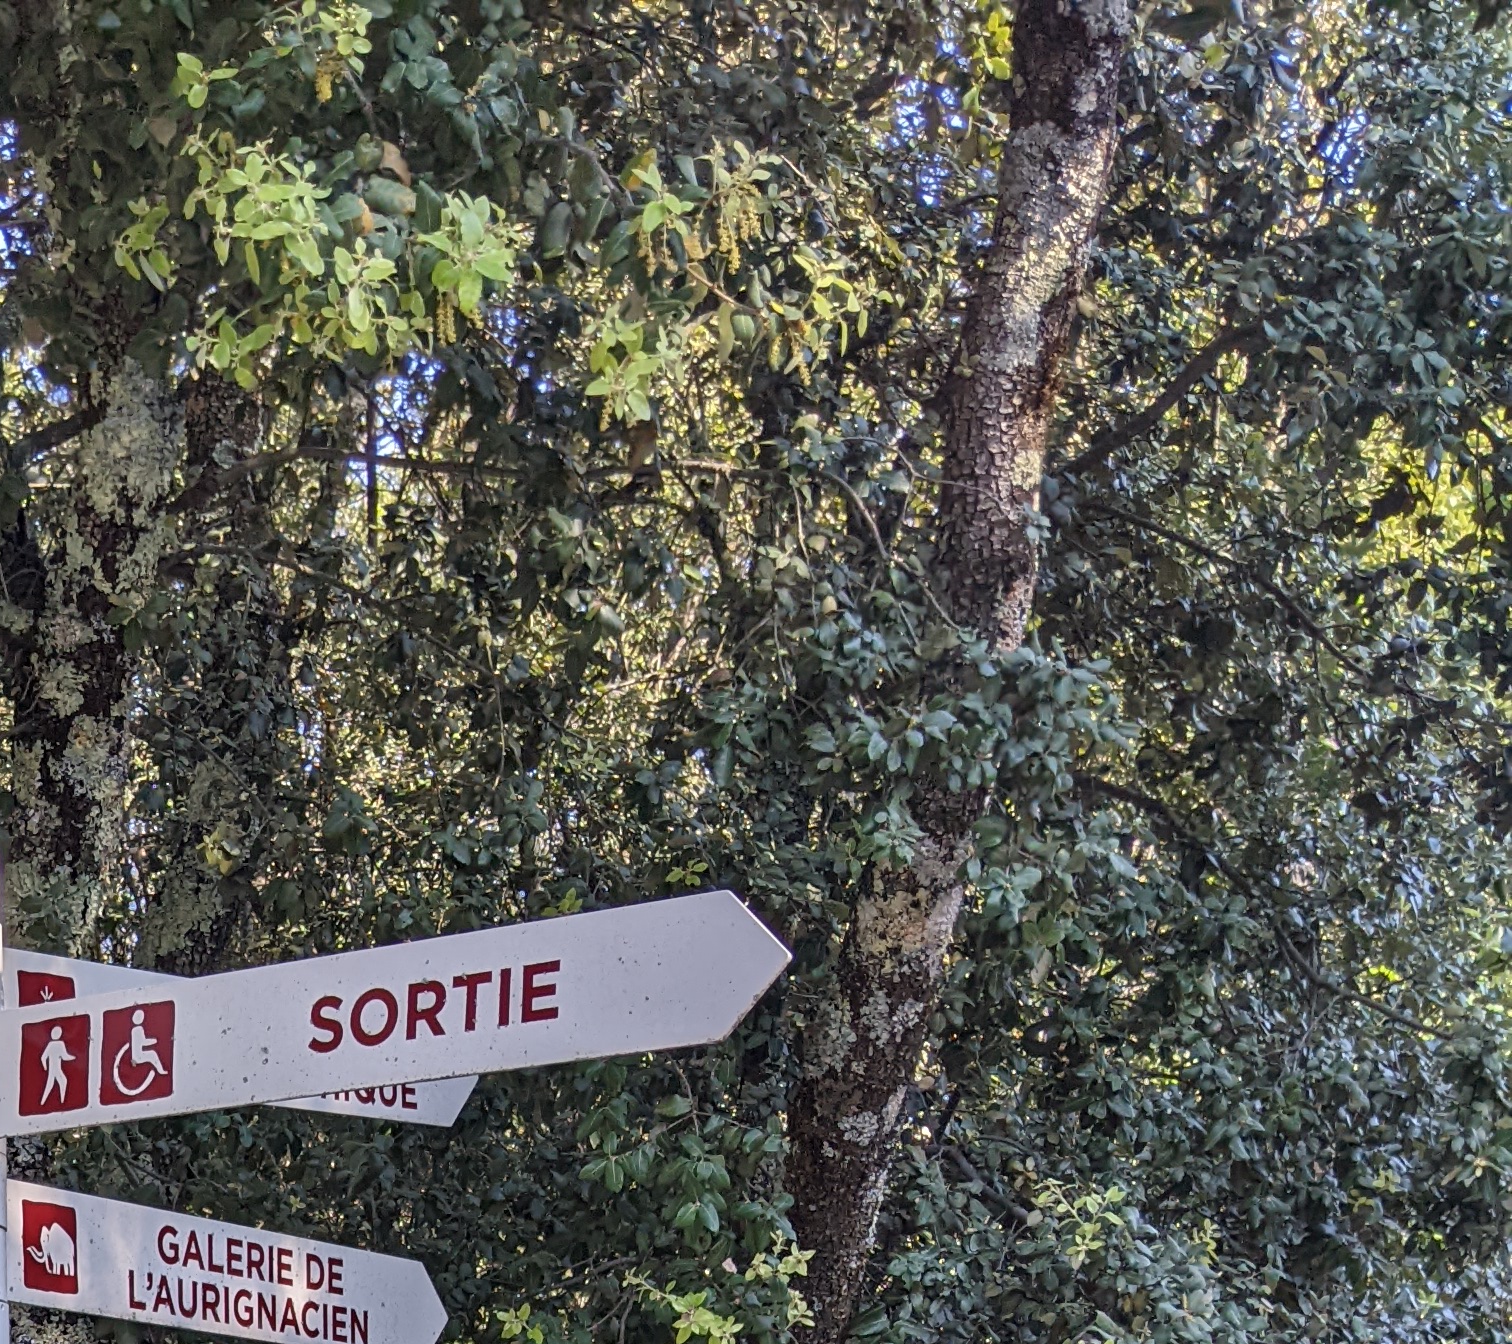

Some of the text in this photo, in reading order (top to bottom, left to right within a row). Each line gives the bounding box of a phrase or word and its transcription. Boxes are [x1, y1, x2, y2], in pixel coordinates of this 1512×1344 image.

[309, 960, 561, 1053] SORTIE
[157, 1225, 344, 1295] GALERIE DE
